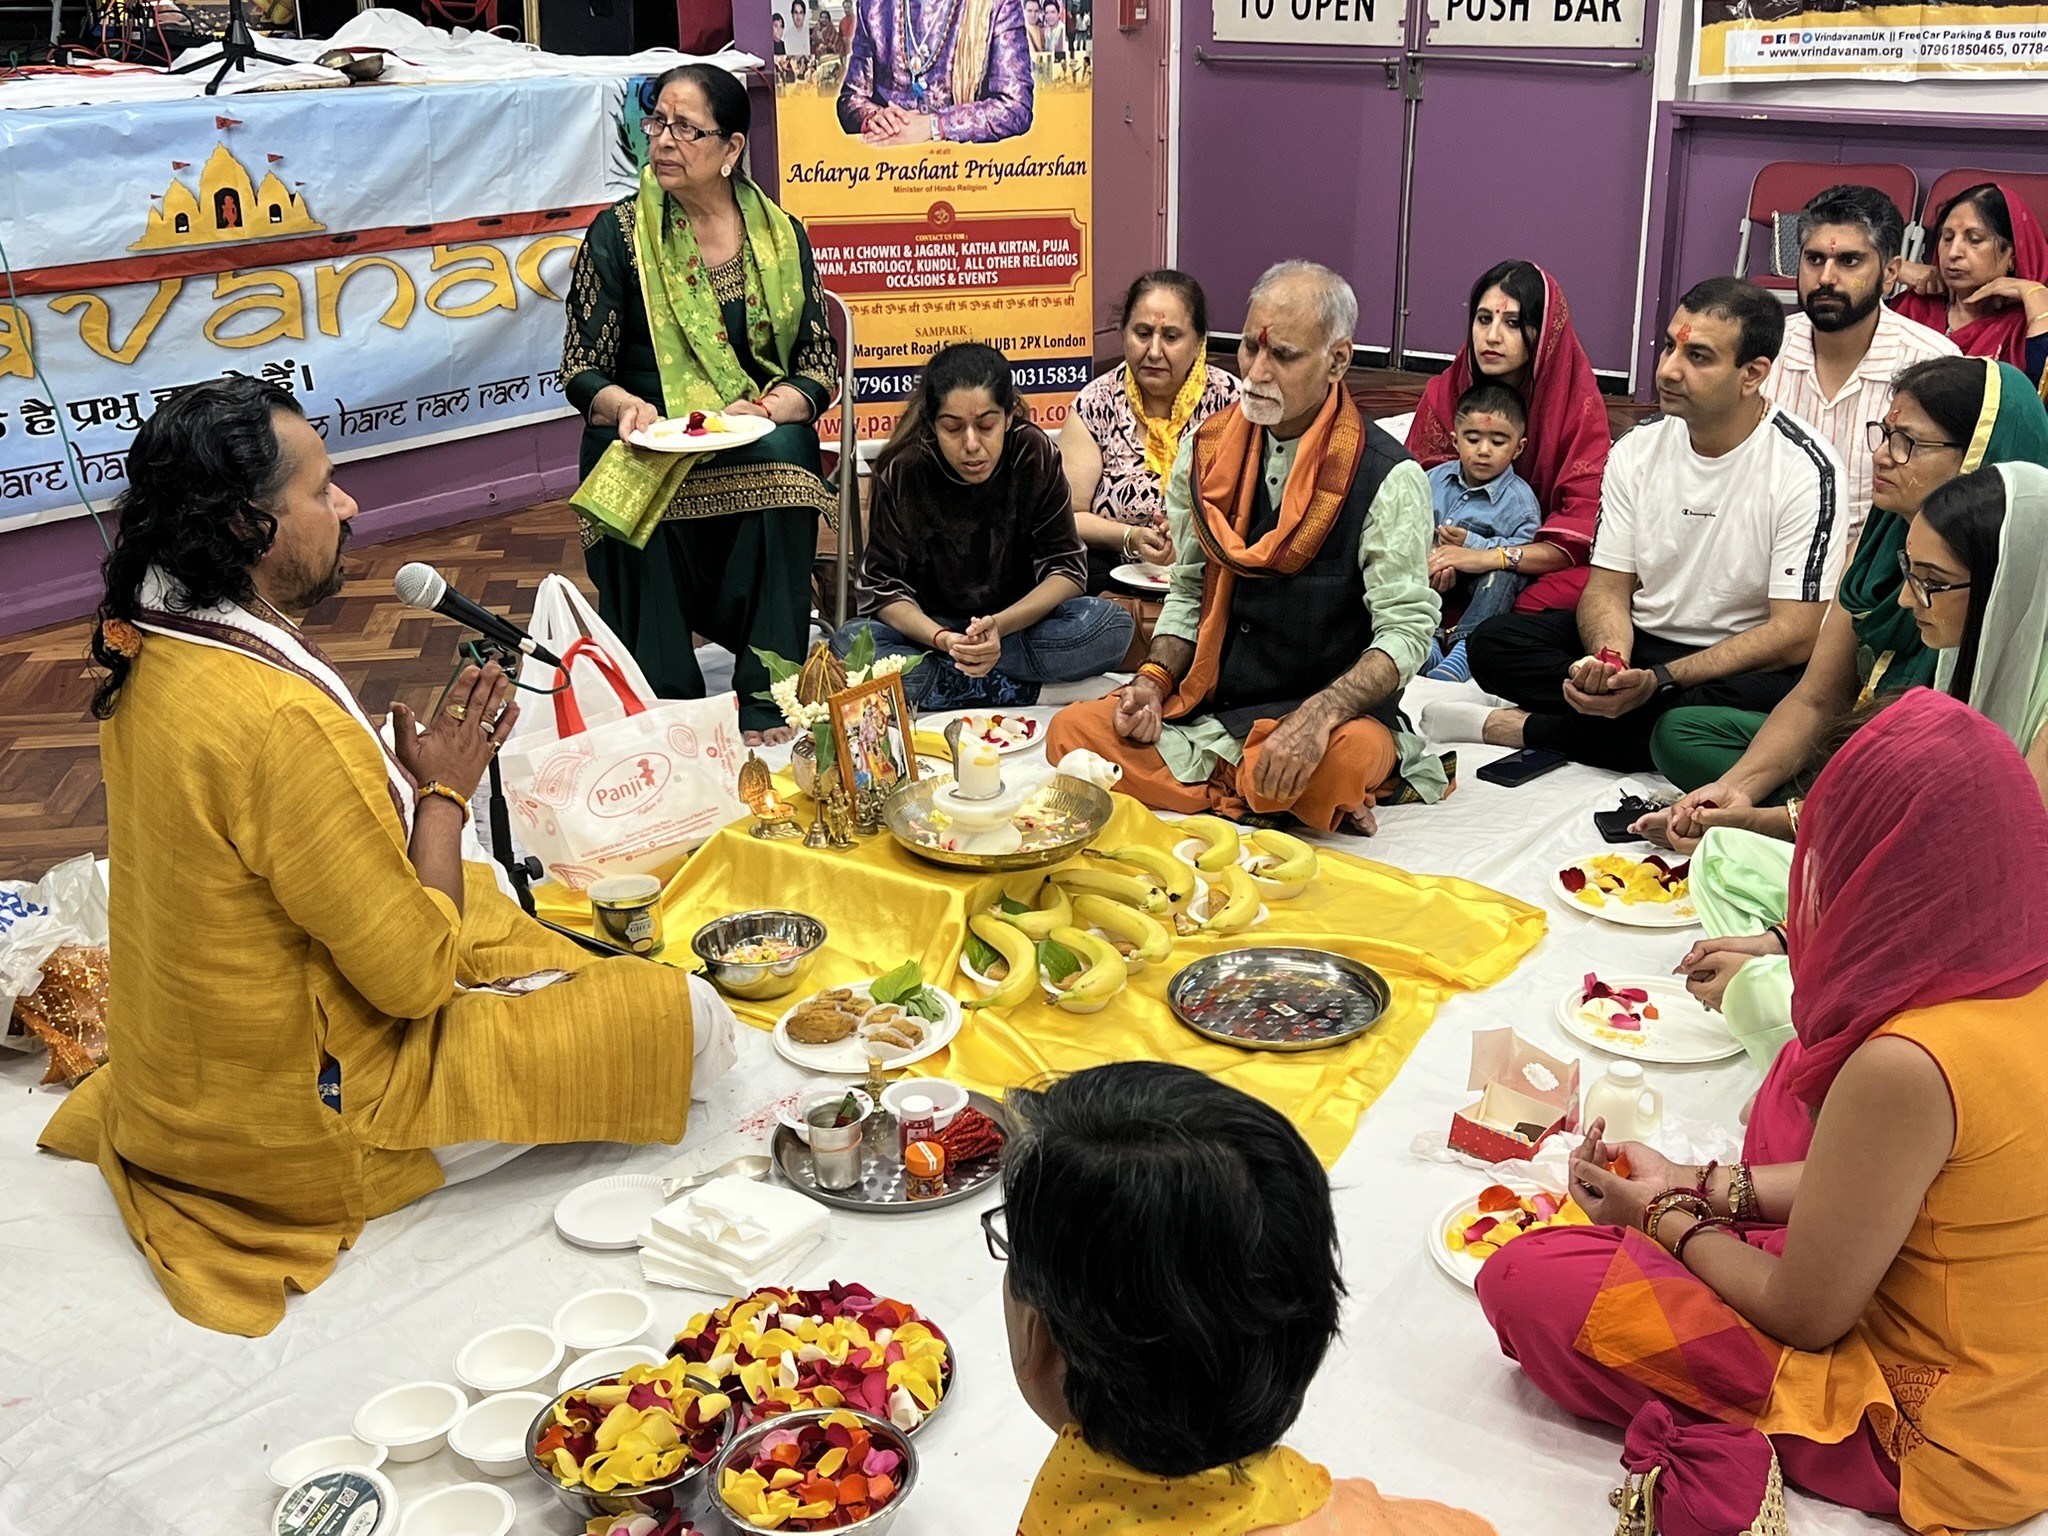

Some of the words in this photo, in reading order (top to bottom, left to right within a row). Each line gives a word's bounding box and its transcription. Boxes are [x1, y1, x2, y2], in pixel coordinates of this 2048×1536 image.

[1291, 0, 1375, 22] OPEN
[1447, 0, 1530, 21] PUSH
[1553, 0, 1622, 22] BAR
[1814, 31, 1885, 42] VrindavanamUK
[1943, 30, 1982, 41] Parking
[1983, 30, 1992, 39] &
[1995, 30, 2016, 39] Bus
[2019, 29, 2047, 39] route
[1769, 45, 1903, 58] www.vrindavanam.org
[786, 160, 871, 189] Acharya
[875, 157, 960, 181] Prashant
[964, 154, 1088, 185] Priyadarshan
[893, 185, 924, 193] Minister
[925, 185, 933, 193] of
[934, 184, 955, 192] Hindu
[957, 183, 988, 192] Religion
[915, 234, 943, 242] CONTACT
[944, 233, 952, 241] US
[811, 247, 841, 260] MATA
[843, 246, 854, 259] KI
[856, 245, 901, 259] CHOWKI
[903, 244, 912, 257] &
[914, 243, 959, 258] JAGRAN,
[961, 241, 997, 255] KATHA
[999, 240, 1040, 254] KIRTAN,
[1043, 239, 1070, 252] PUJA
[849, 260, 914, 274] ASTROLOGY,
[917, 258, 960, 273] KUNDLI,
[965, 257, 985, 270] ALL
[986, 256, 1021, 269] OTHER
[1023, 253, 1079, 268] RELIGIOUS
[886, 273, 946, 288] OCCASIONS
[947, 272, 957, 286] &
[958, 271, 999, 285] EVENTS
[915, 325, 967, 338] SAMPARK
[854, 343, 908, 361] Margaret
[911, 340, 941, 355] Road
[995, 336, 1017, 351] UB1
[1020, 335, 1041, 349] 2PX
[1043, 334, 1086, 348] London
[67, 393, 144, 431] प्रभु
[335, 398, 408, 437] hare
[416, 388, 471, 422] ram
[478, 376, 531, 409] ram
[595, 777, 642, 806] Panji
